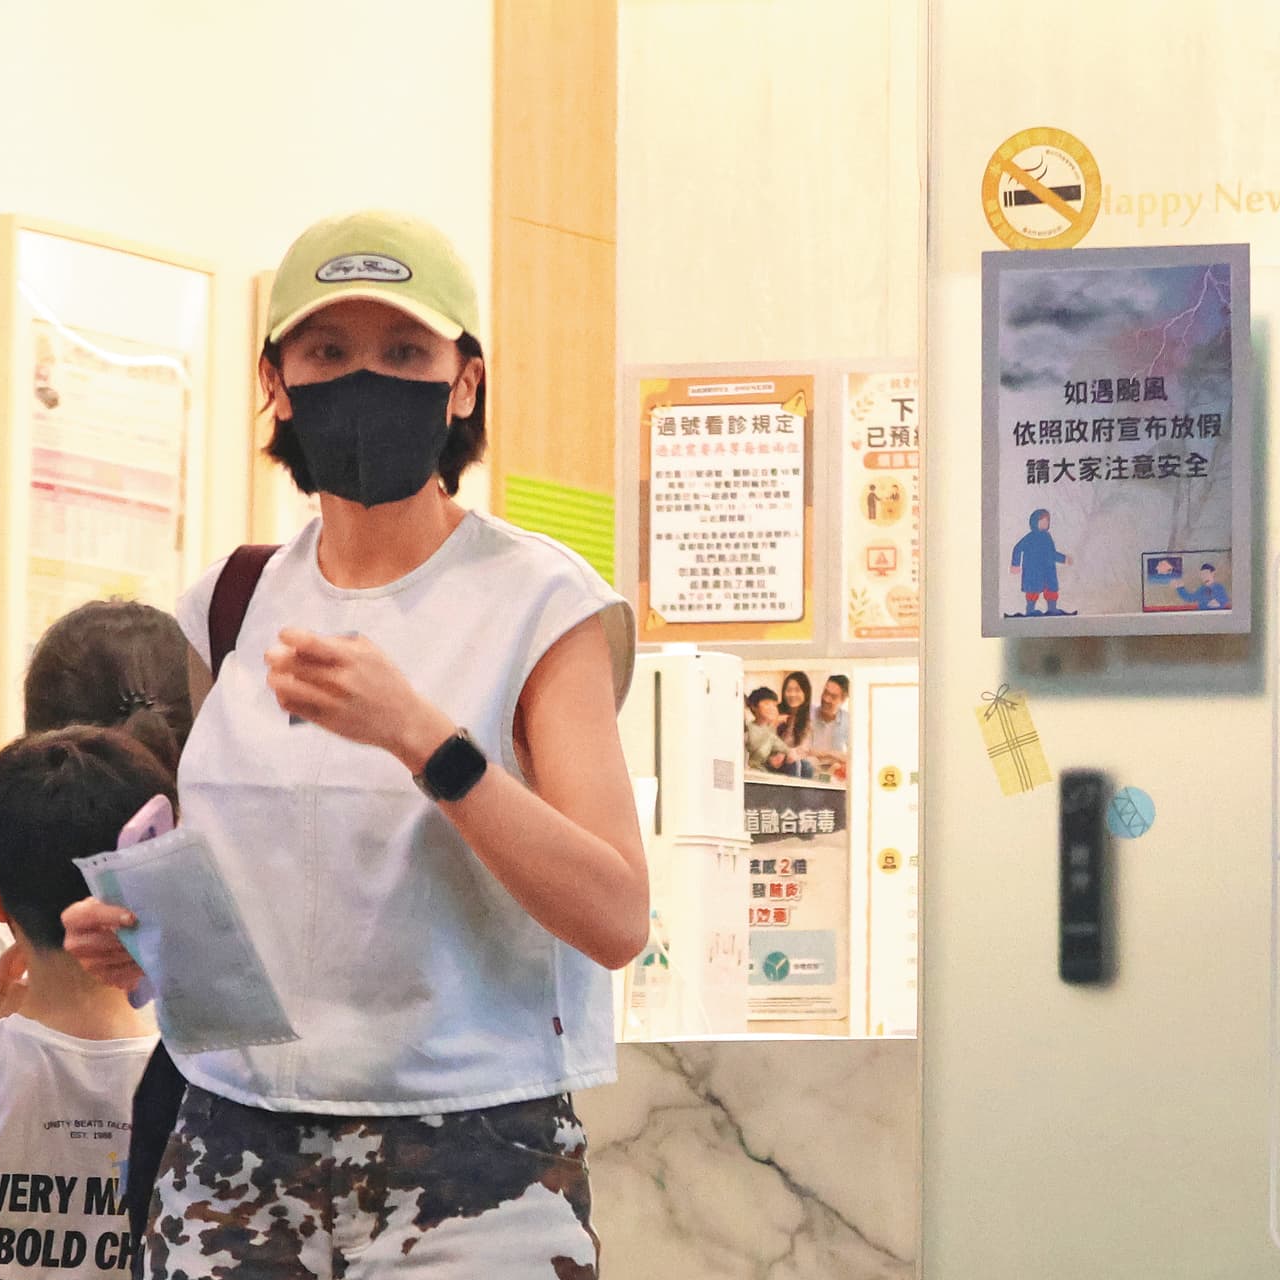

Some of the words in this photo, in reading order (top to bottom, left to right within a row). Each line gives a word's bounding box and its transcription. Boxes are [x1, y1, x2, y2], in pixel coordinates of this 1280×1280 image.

[1064, 378, 1168, 405] 如遇颱風
[656, 414, 795, 436] 過號看診規定
[1013, 413, 1222, 447] 依照政府宣布放假
[1026, 452, 1210, 485] 請大家注意安全
